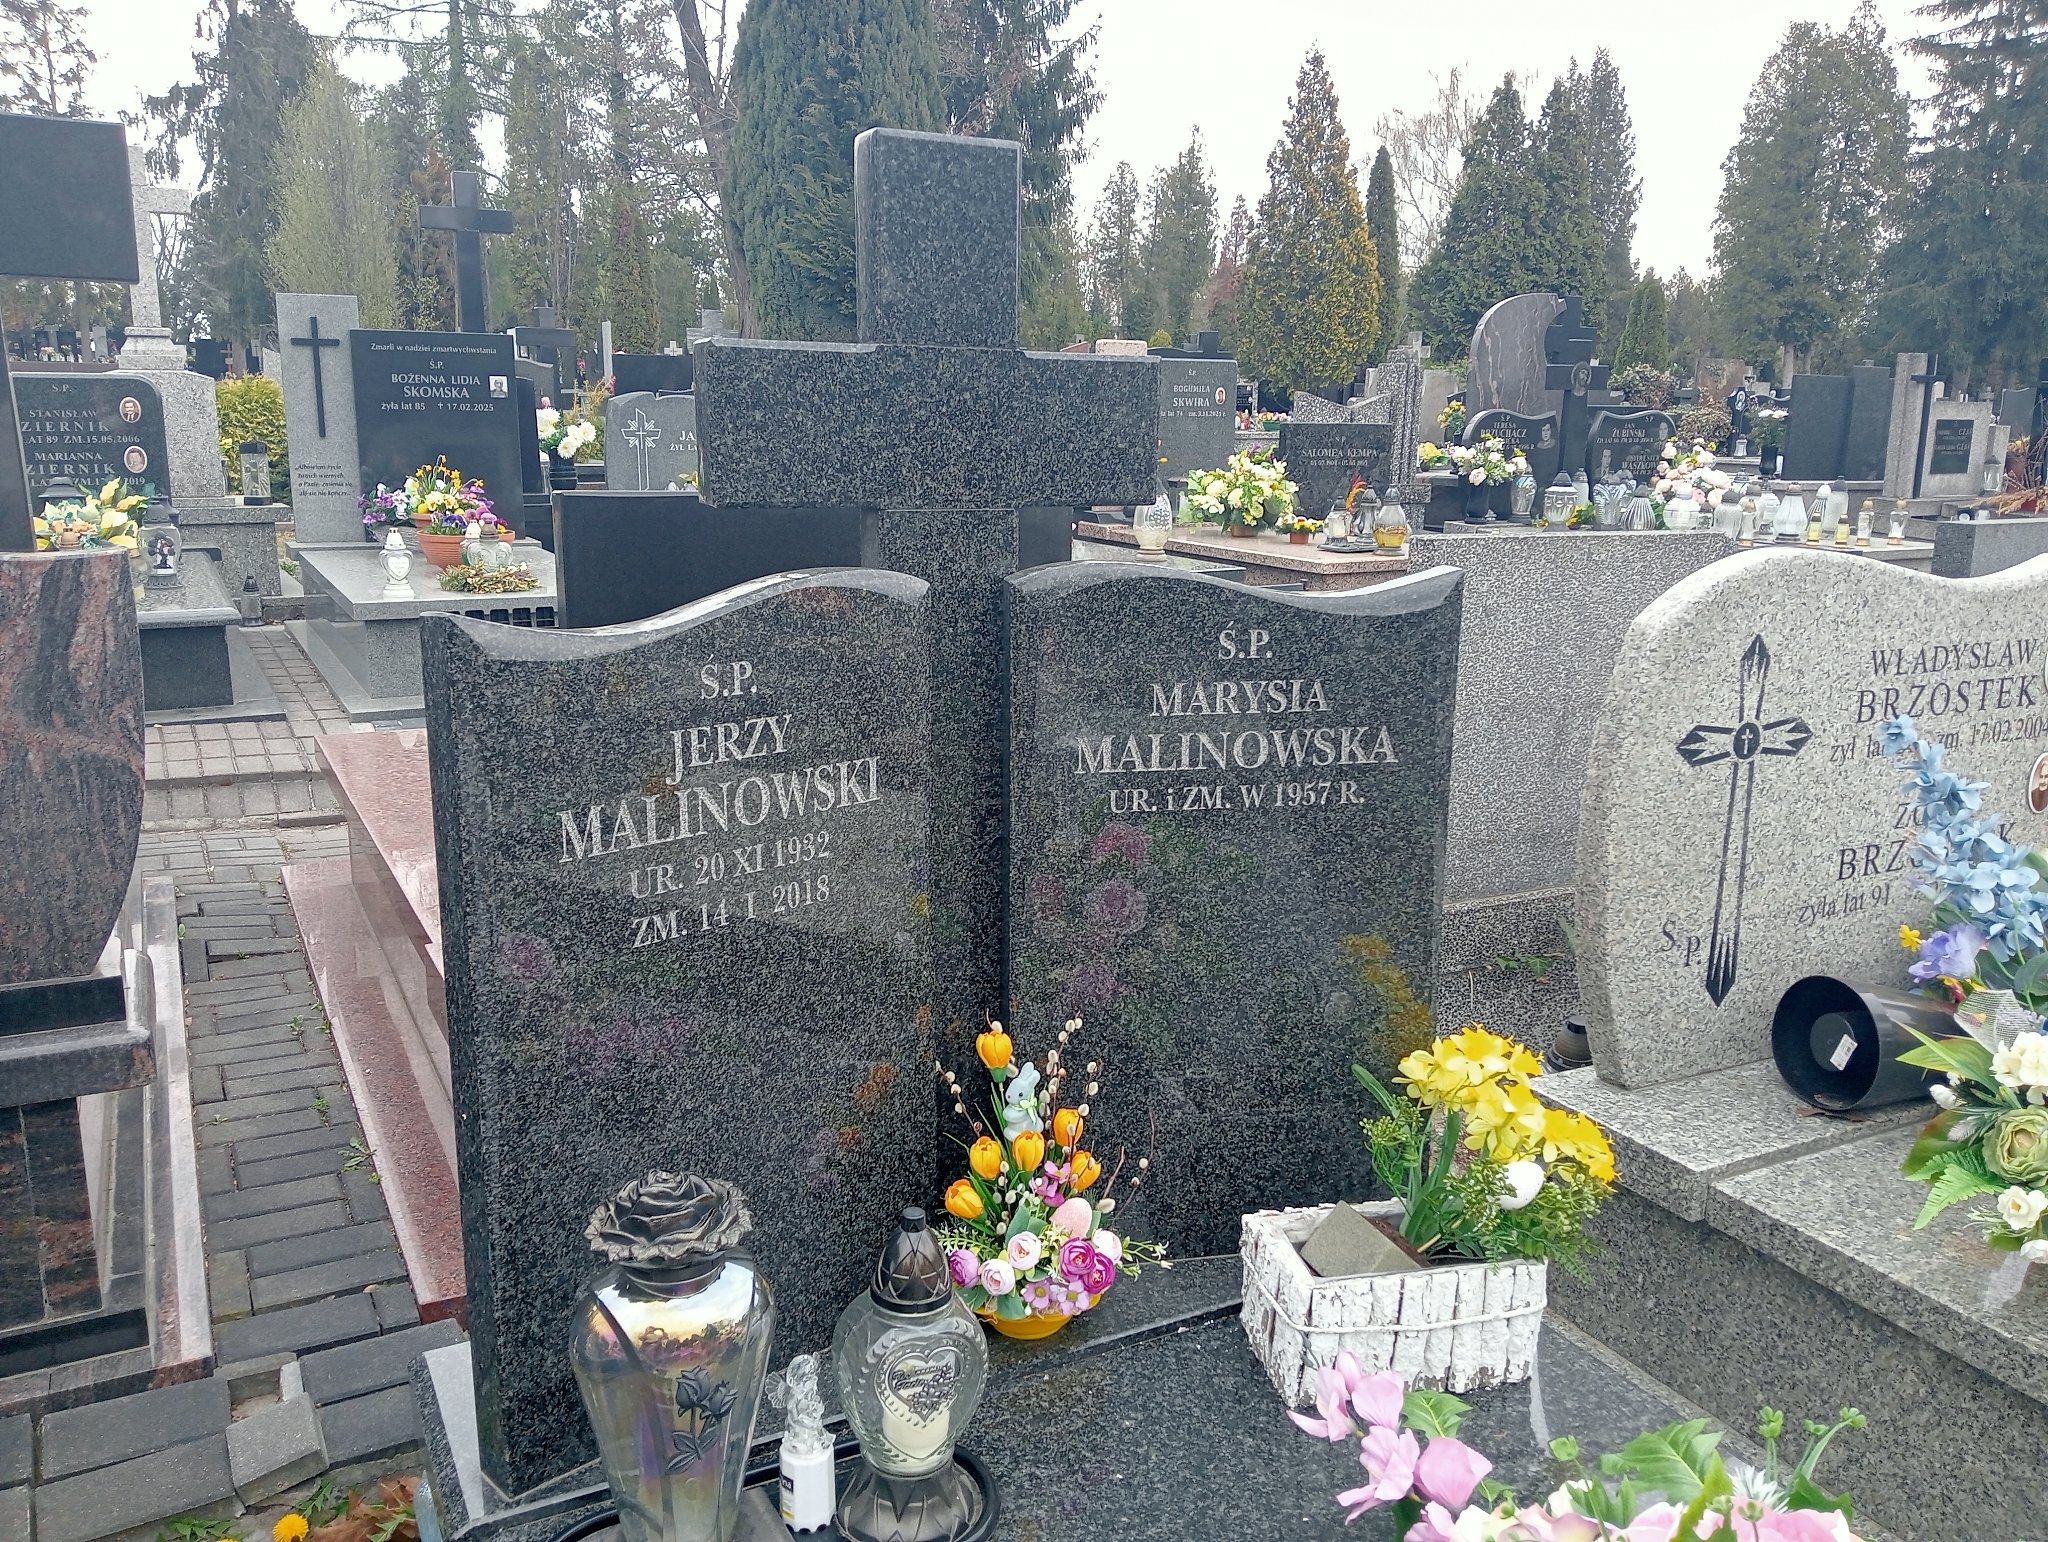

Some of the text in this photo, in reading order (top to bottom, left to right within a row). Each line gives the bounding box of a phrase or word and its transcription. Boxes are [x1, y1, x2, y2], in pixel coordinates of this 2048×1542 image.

[405, 344, 431, 352] nadziei
[391, 373, 480, 385] BOŻENNA LIDIA
[403, 386, 470, 398] SKOMSKA
[401, 401, 412, 410] lat
[415, 402, 426, 410] 85
[447, 403, 494, 412] 17.02.2025
[1173, 398, 1210, 407] SKWIRA
[29, 410, 97, 418] STANISŁAW
[21, 421, 110, 431] ZIERNIK
[24, 436, 43, 444] AT
[46, 435, 58, 444] 89
[680, 430, 695, 441] JA
[34, 452, 102, 460] MARIANNA
[1302, 448, 1377, 457] SALOMEA KEMPA
[26, 464, 115, 475] ZIERNIK
[1217, 621, 1273, 660] Ś.P.
[700, 654, 758, 700] Ś.P.
[1150, 679, 1331, 717] MARYSIA
[1856, 674, 2038, 724] BRZOSTEK
[666, 714, 792, 786] JERZY
[1074, 725, 1399, 774] MALINOWSKA
[1109, 780, 1365, 814] UR. i ZM. W 1957 R.
[555, 756, 882, 863] MALINOWSKI
[629, 830, 830, 900] UR. 20 XI 1932
[1842, 892, 1868, 914] lat
[1871, 882, 1890, 908] 91
[632, 874, 830, 949] ZM. 14 I 2018
